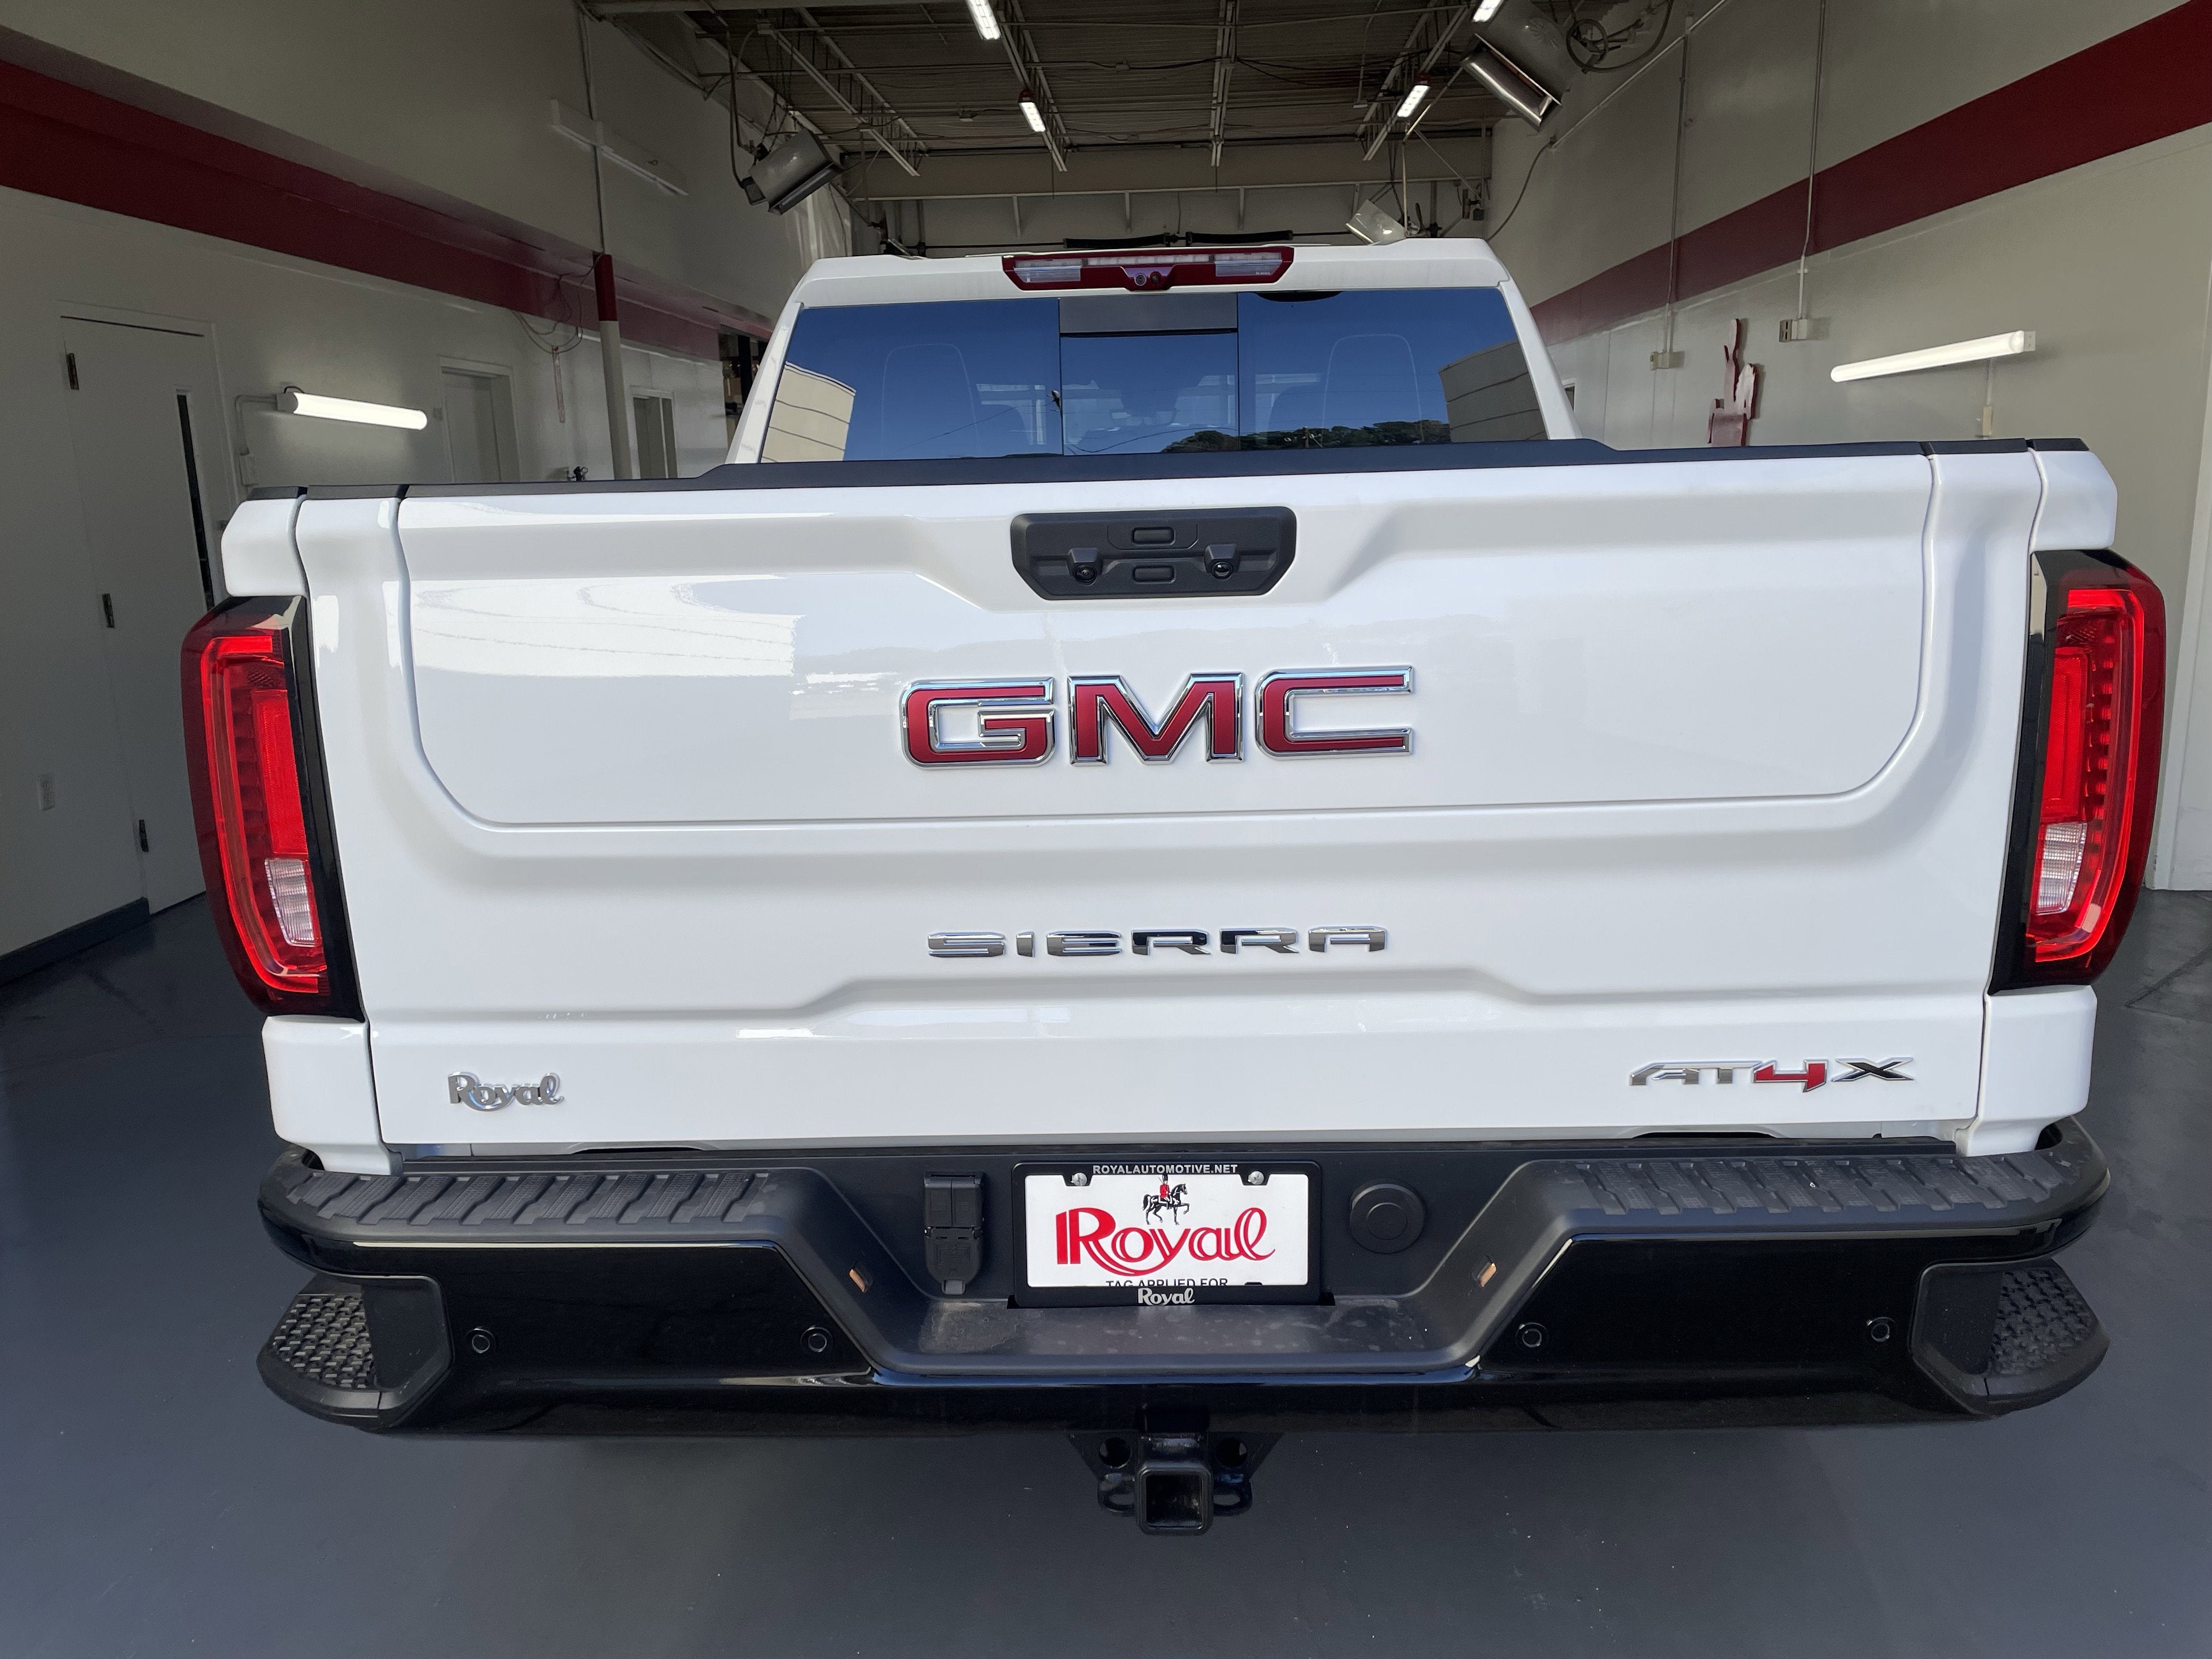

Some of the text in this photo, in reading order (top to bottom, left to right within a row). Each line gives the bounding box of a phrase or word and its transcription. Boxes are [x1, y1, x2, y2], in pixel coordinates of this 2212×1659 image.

[900, 665, 1413, 768] GMC
[927, 926, 1388, 958] SIERRA
[447, 1071, 565, 1111] Royal
[1630, 1057, 1915, 1092] AT4X
[1093, 1164, 1238, 1175] ROYALAUTOMOTIVE.NET
[1055, 1207, 1276, 1277] Royal
[1137, 1287, 1195, 1306] Royal
